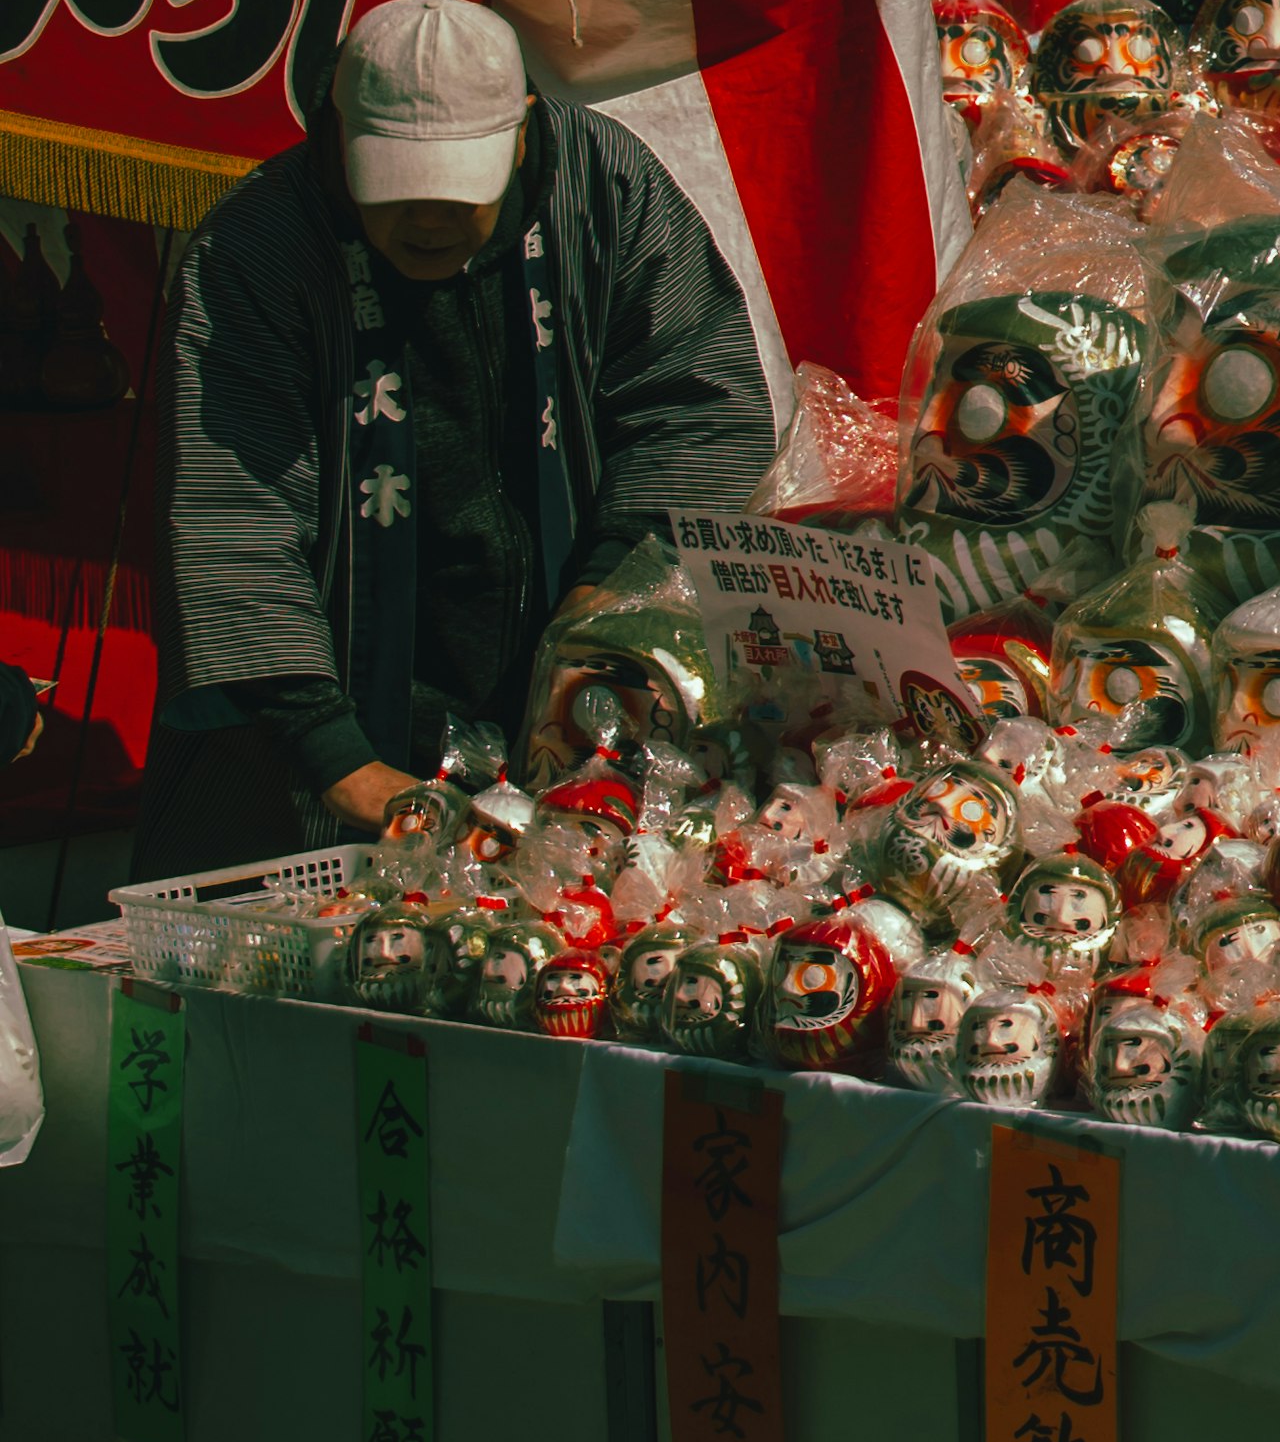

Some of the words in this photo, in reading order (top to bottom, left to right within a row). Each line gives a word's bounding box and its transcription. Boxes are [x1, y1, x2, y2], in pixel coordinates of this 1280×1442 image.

[678, 516, 925, 586] お買い求め頂いた「だるま」に
[711, 560, 904, 625] 僧侶が目入れを致します
[746, 646, 788, 665] 目入れ所
[113, 1028, 182, 1414] 学業成就
